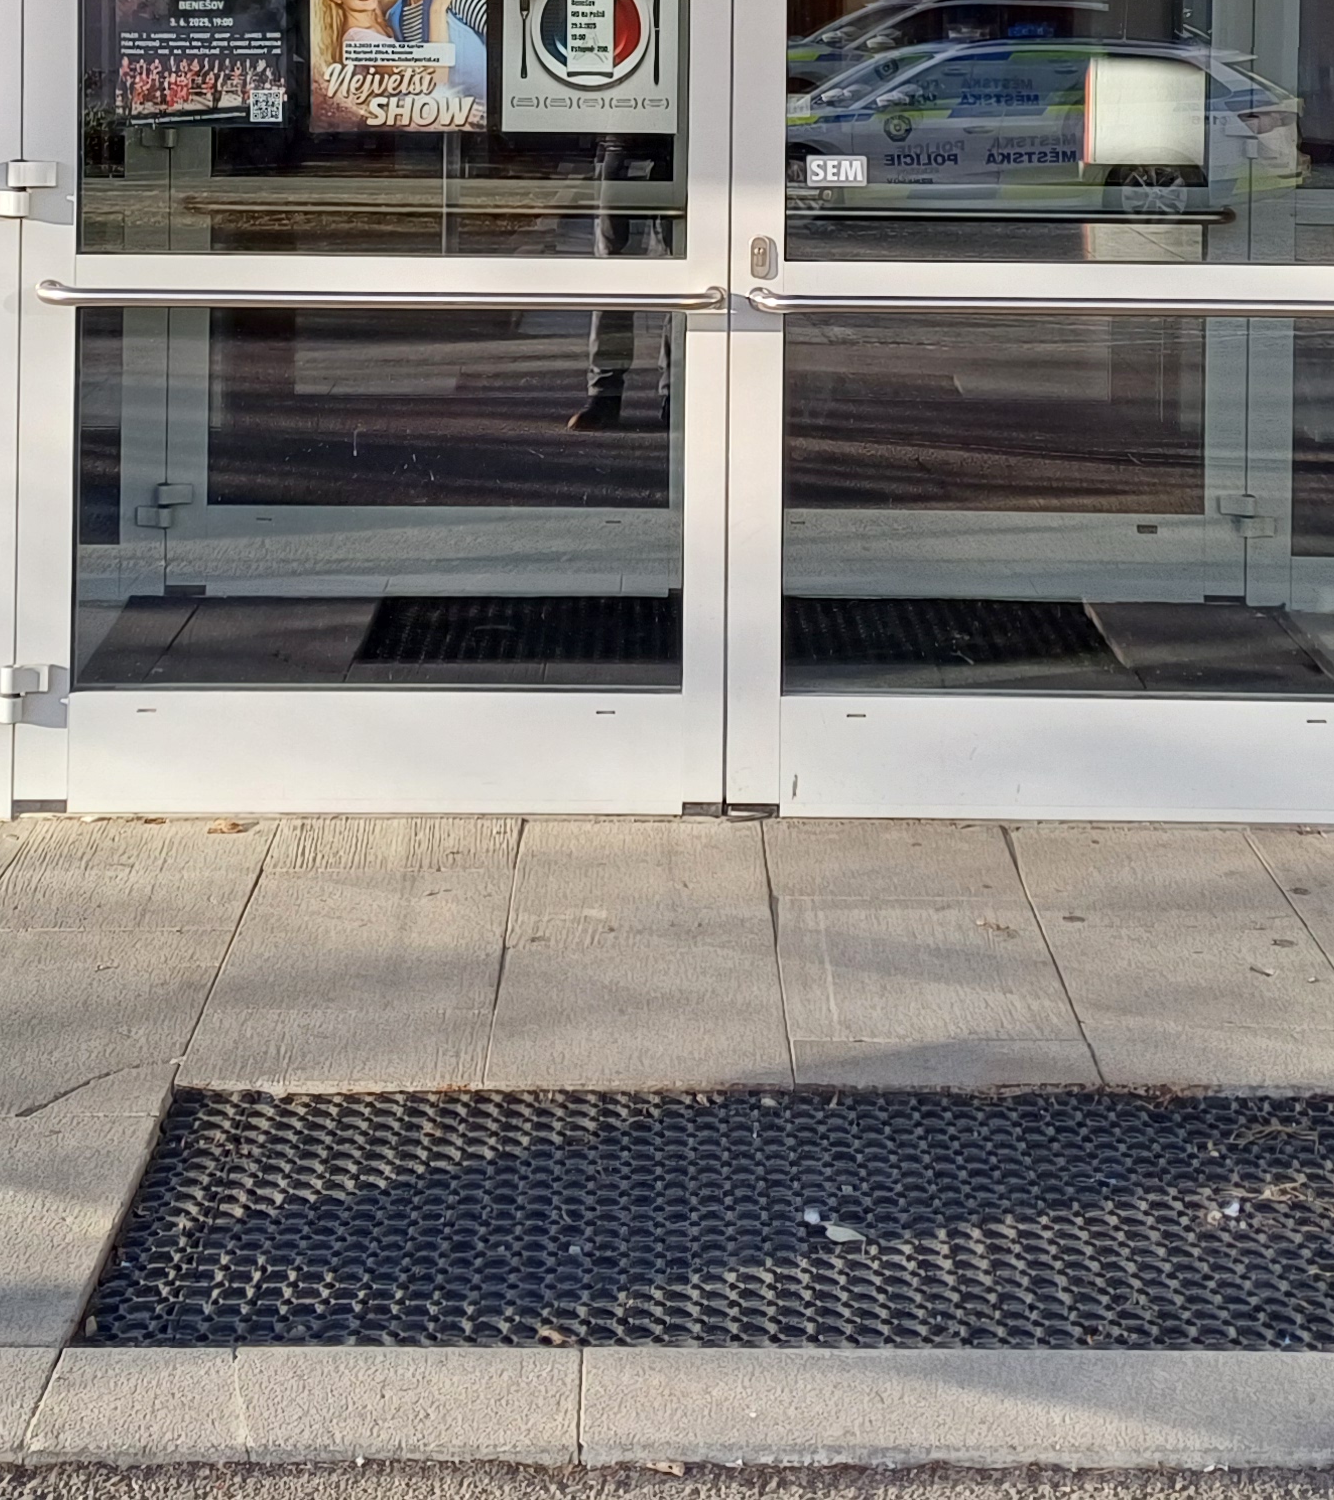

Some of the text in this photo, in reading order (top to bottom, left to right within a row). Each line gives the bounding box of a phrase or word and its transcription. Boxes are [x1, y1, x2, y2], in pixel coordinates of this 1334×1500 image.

[179, 0, 224, 9] BENEŠOV
[170, 18, 177, 26] 3.
[324, 63, 436, 105] Největší
[367, 96, 474, 126] SHOW
[811, 161, 863, 181] SEM
